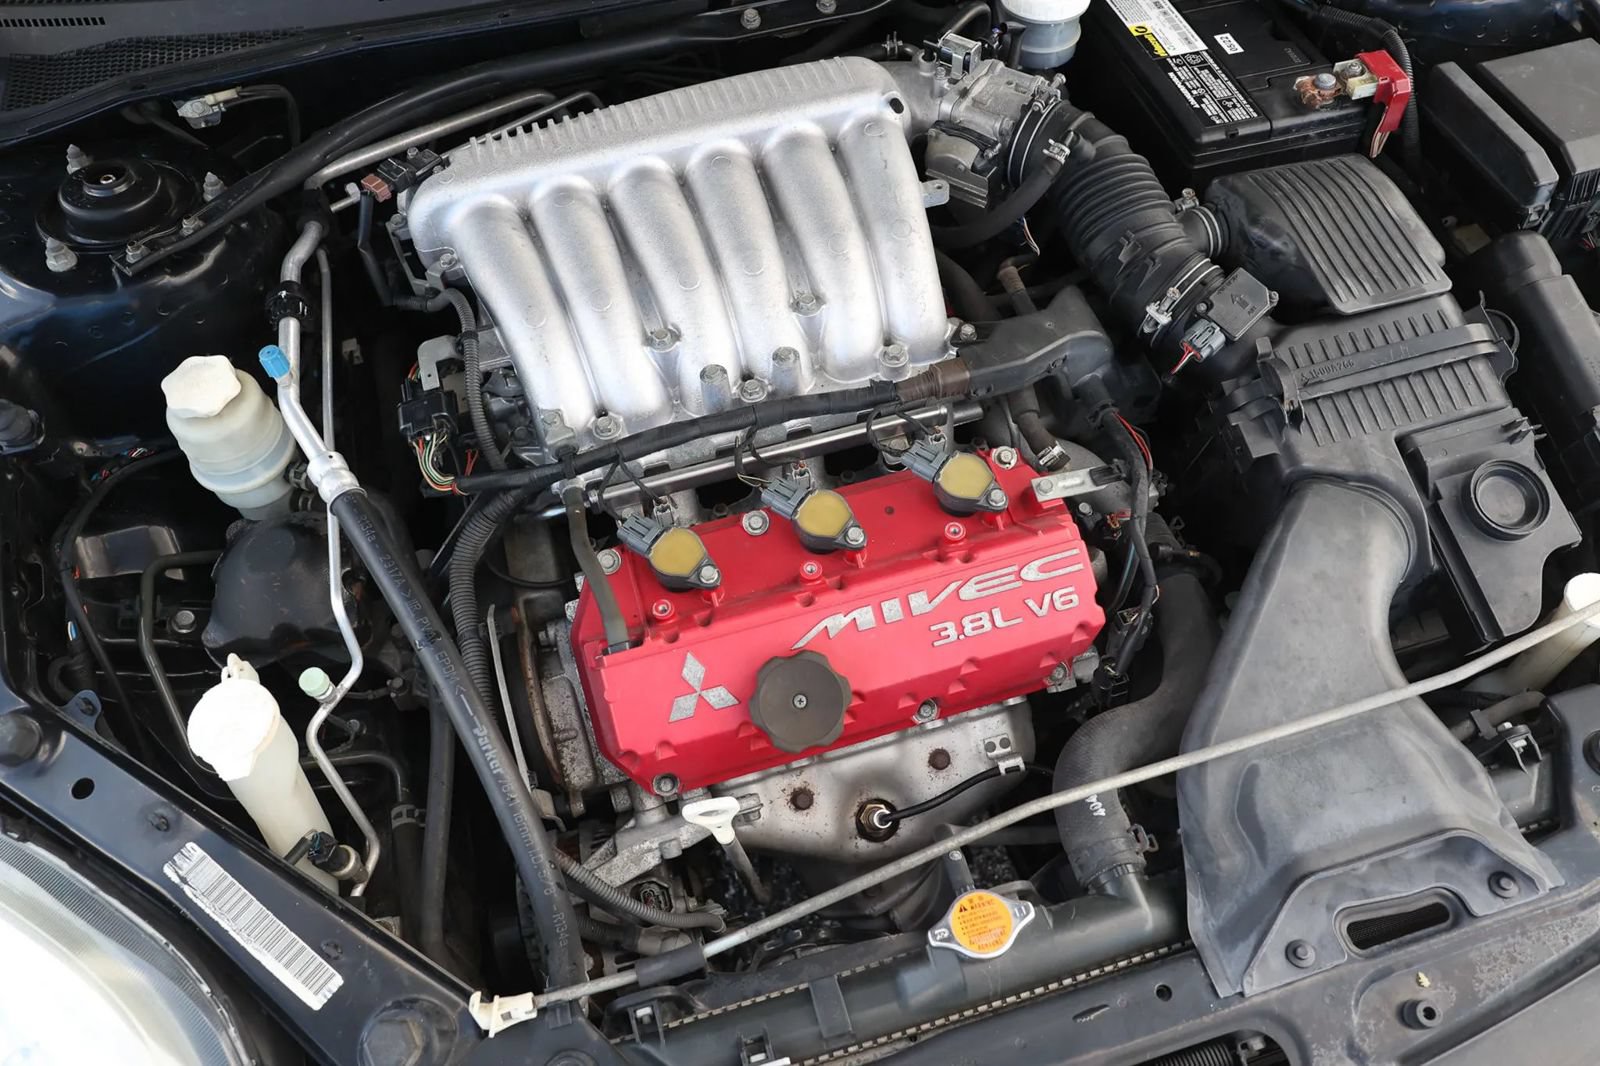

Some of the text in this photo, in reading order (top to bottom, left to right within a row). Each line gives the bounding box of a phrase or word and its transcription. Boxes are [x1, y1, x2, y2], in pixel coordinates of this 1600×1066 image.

[791, 548, 1085, 650] MIVEC
[929, 586, 1080, 648] 3.8L V6
[472, 724, 506, 775] Parker
